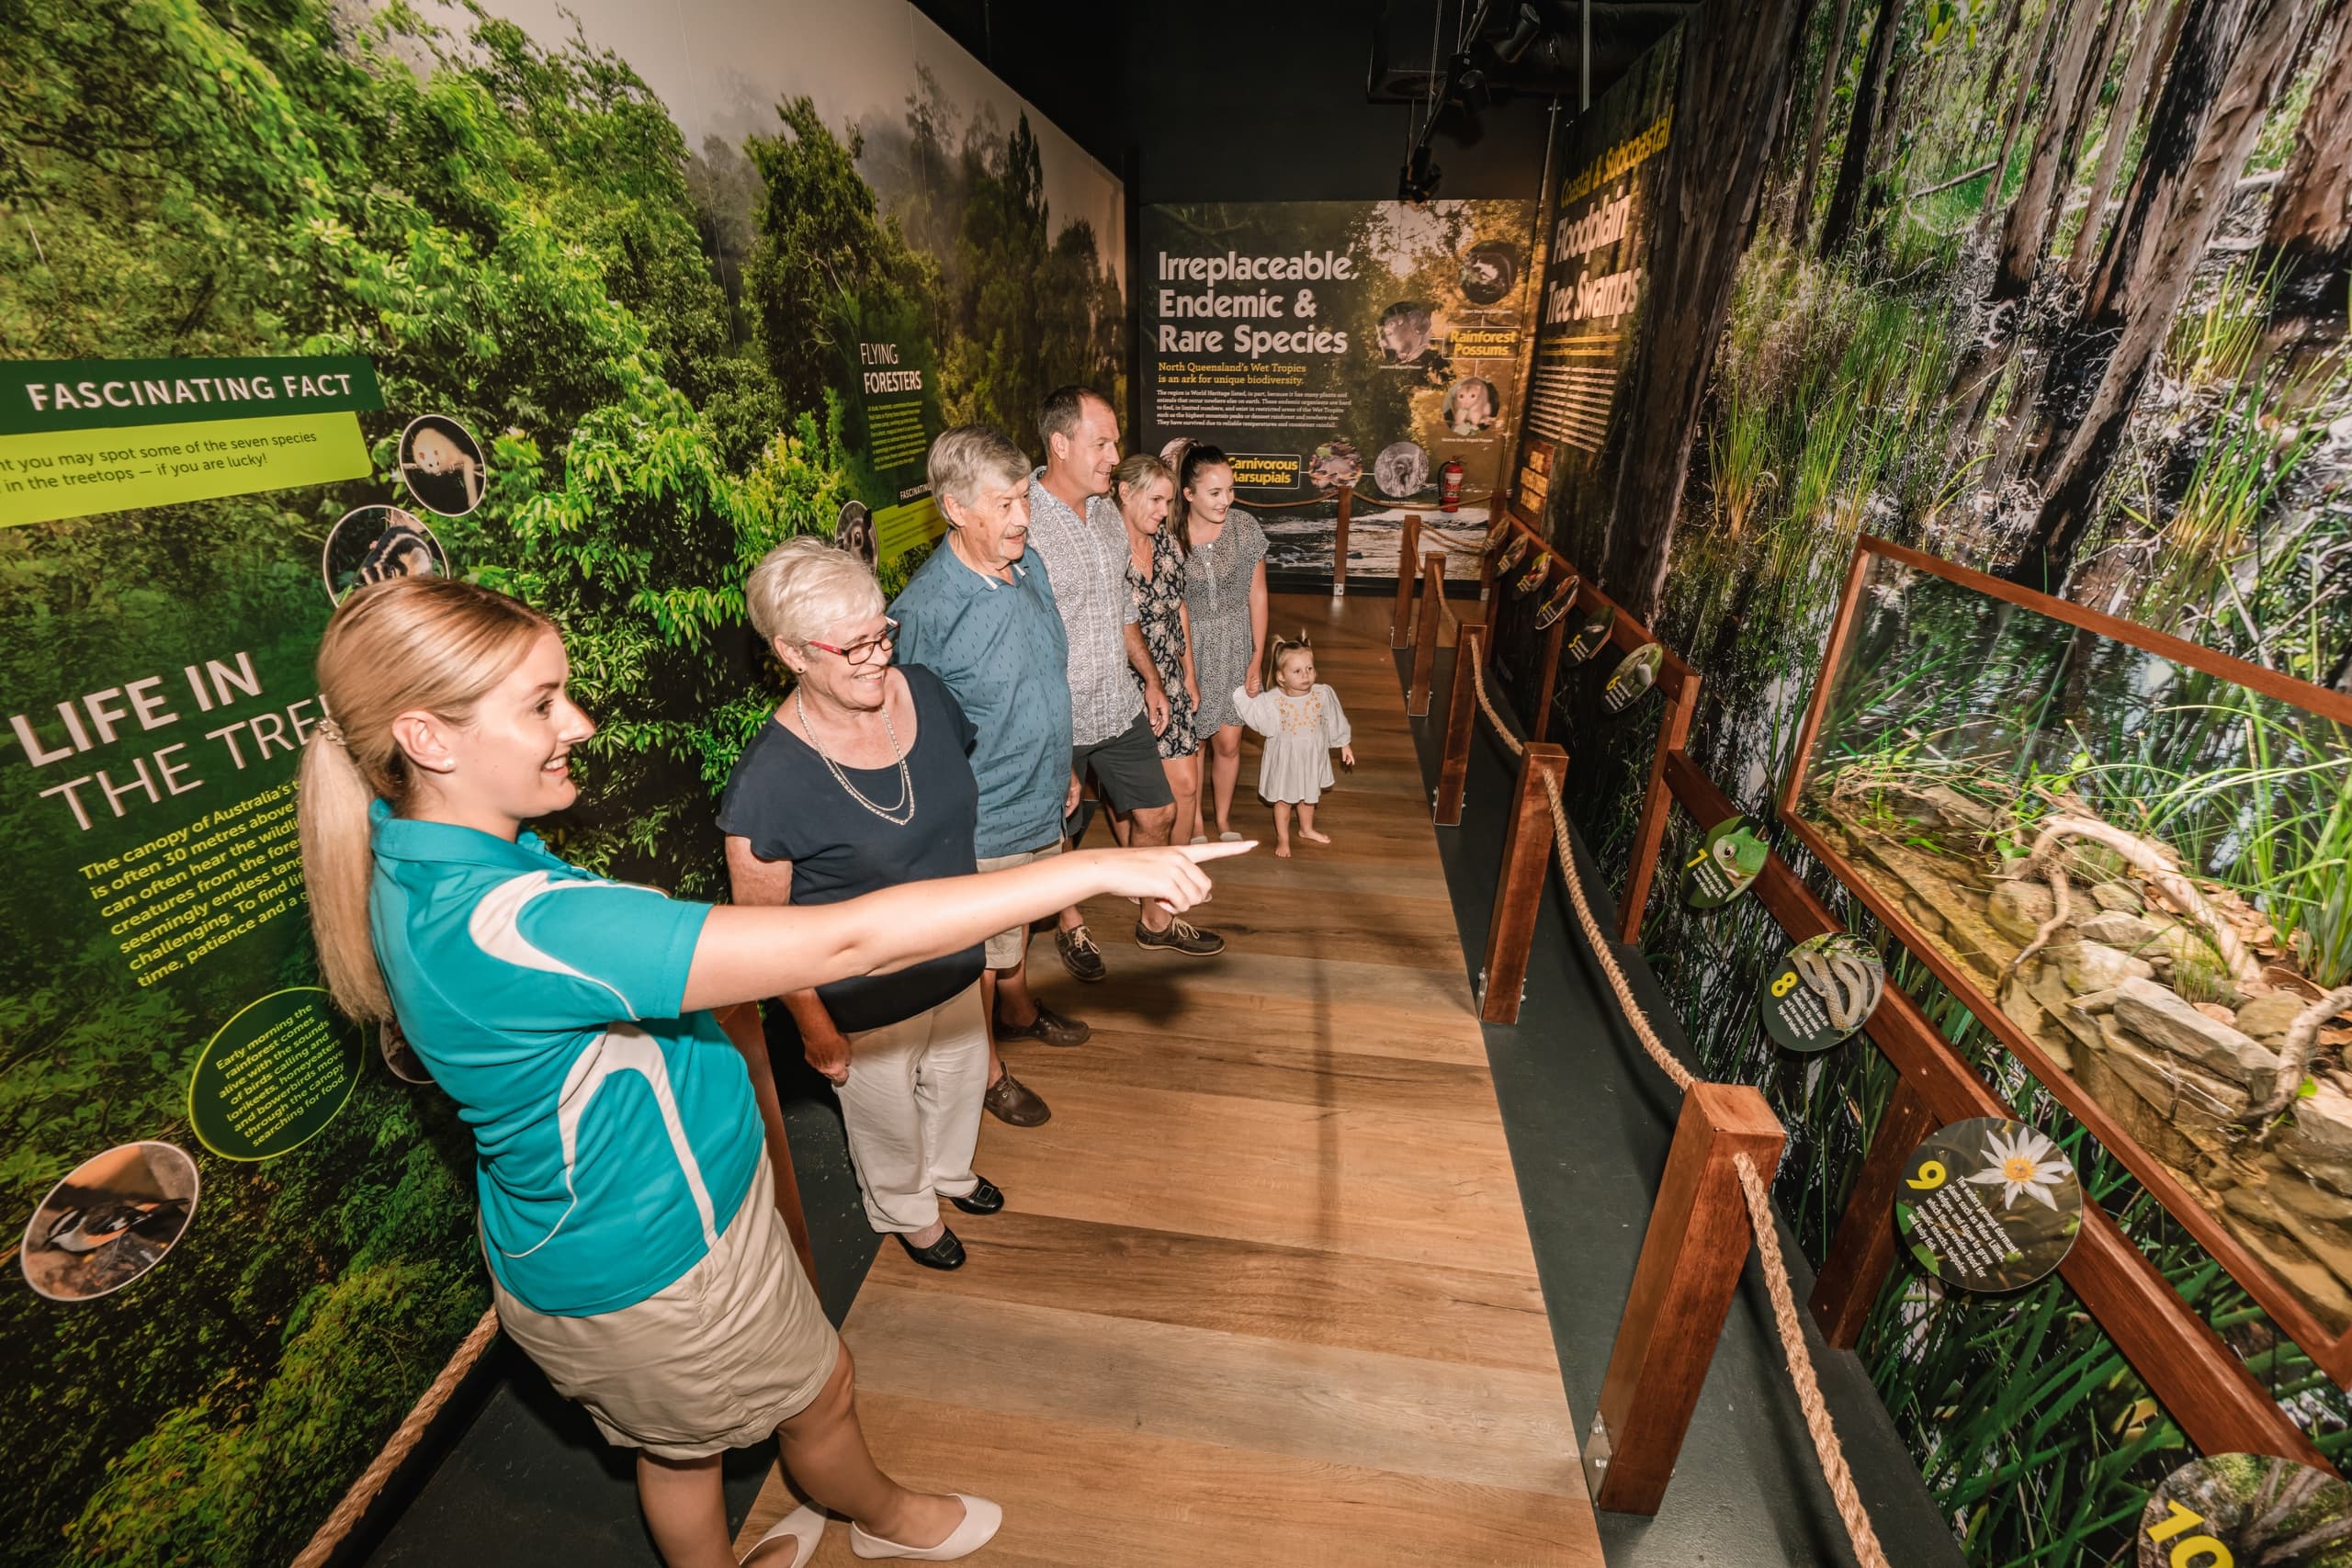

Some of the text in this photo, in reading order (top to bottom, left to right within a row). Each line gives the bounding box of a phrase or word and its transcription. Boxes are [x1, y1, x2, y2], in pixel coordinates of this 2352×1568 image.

[1602, 103, 1675, 185] Subcoastal
[1553, 185, 1632, 265] Floodplain
[1159, 250, 1360, 287] Irreplaceable,
[1159, 288, 1317, 318] Endemic &
[1546, 266, 1642, 329] Tree Swamps
[860, 343, 899, 365] FLYING
[1159, 324, 1349, 359] Rare Species
[1450, 331, 1517, 343] Rainforest
[1454, 344, 1509, 355] Possums
[25, 374, 352, 412] FASCINATING FACT
[864, 370, 922, 394] FORESTERS
[1159, 362, 1306, 374] North Queensland's Wet Tropics
[1159, 374, 1167, 383] is
[1182, 374, 1196, 383] ark
[1199, 374, 1212, 383] for
[1214, 375, 1245, 386] unique
[1247, 375, 1304, 386] biodiversity.
[5, 479, 24, 493] in
[28, 476, 59, 490] the
[62, 468, 135, 486] treetops
[155, 463, 167, 476] if
[170, 462, 199, 478] you
[202, 459, 225, 471] are
[227, 452, 268, 468] lucky!
[17, 457, 53, 473] you
[58, 452, 95, 467] may
[99, 447, 137, 463] spot
[140, 445, 181, 458] some
[185, 441, 201, 454] of
[203, 439, 228, 452] the
[231, 435, 269, 449] seven
[272, 432, 317, 447] species
[9, 651, 264, 768] LIFE IN
[39, 742, 206, 831] THE
[78, 784, 291, 880] The canopy of Australia's
[89, 803, 295, 900] is often 30 metres above
[101, 895, 137, 918] can
[139, 871, 188, 899] often
[188, 852, 226, 876] hear
[229, 839, 257, 857] the
[110, 888, 196, 935] creatures
[197, 868, 238, 894] from
[239, 854, 266, 873] the
[119, 902, 209, 954] seemingly
[211, 872, 271, 907] endless
[129, 912, 234, 971] challenging.
[233, 899, 256, 914] To
[257, 879, 288, 904] find
[137, 960, 185, 987] time,
[186, 919, 256, 964] patience
[257, 899, 287, 923] and
[288, 897, 298, 907] a
[1771, 971, 1798, 998] 8
[215, 1004, 312, 1070] Early morning the
[219, 1020, 330, 1099] alive with the sounds
[224, 1016, 315, 1080] rainforest comes
[278, 1039, 340, 1086] honeyeaters
[230, 1032, 330, 1105] of birds calling and
[234, 1050, 344, 1132] and bowerbirds move
[243, 1062, 345, 1138] through the canopy
[252, 1106, 305, 1147] searching
[304, 1092, 320, 1108] for
[1905, 1160, 1947, 1190] 9
[1907, 1213, 1919, 1224] and
[1915, 1223, 1928, 1239] baby
[1916, 1205, 1934, 1226] aquatic
[1927, 1198, 1986, 1277] which then provides food for
[1944, 1184, 1962, 1201] plants
[1959, 1201, 1973, 1216] such
[1970, 1215, 1978, 1224] as
[1975, 1222, 1992, 1240] Water
[1952, 1213, 1965, 1225] and
[1956, 1176, 2018, 1254] The waters prompt dormant
[1960, 1224, 1975, 1242] Algae
[1973, 1240, 1980, 1248] to
[1976, 1248, 1993, 1264] grow
[2145, 1498, 2235, 1568] 10
